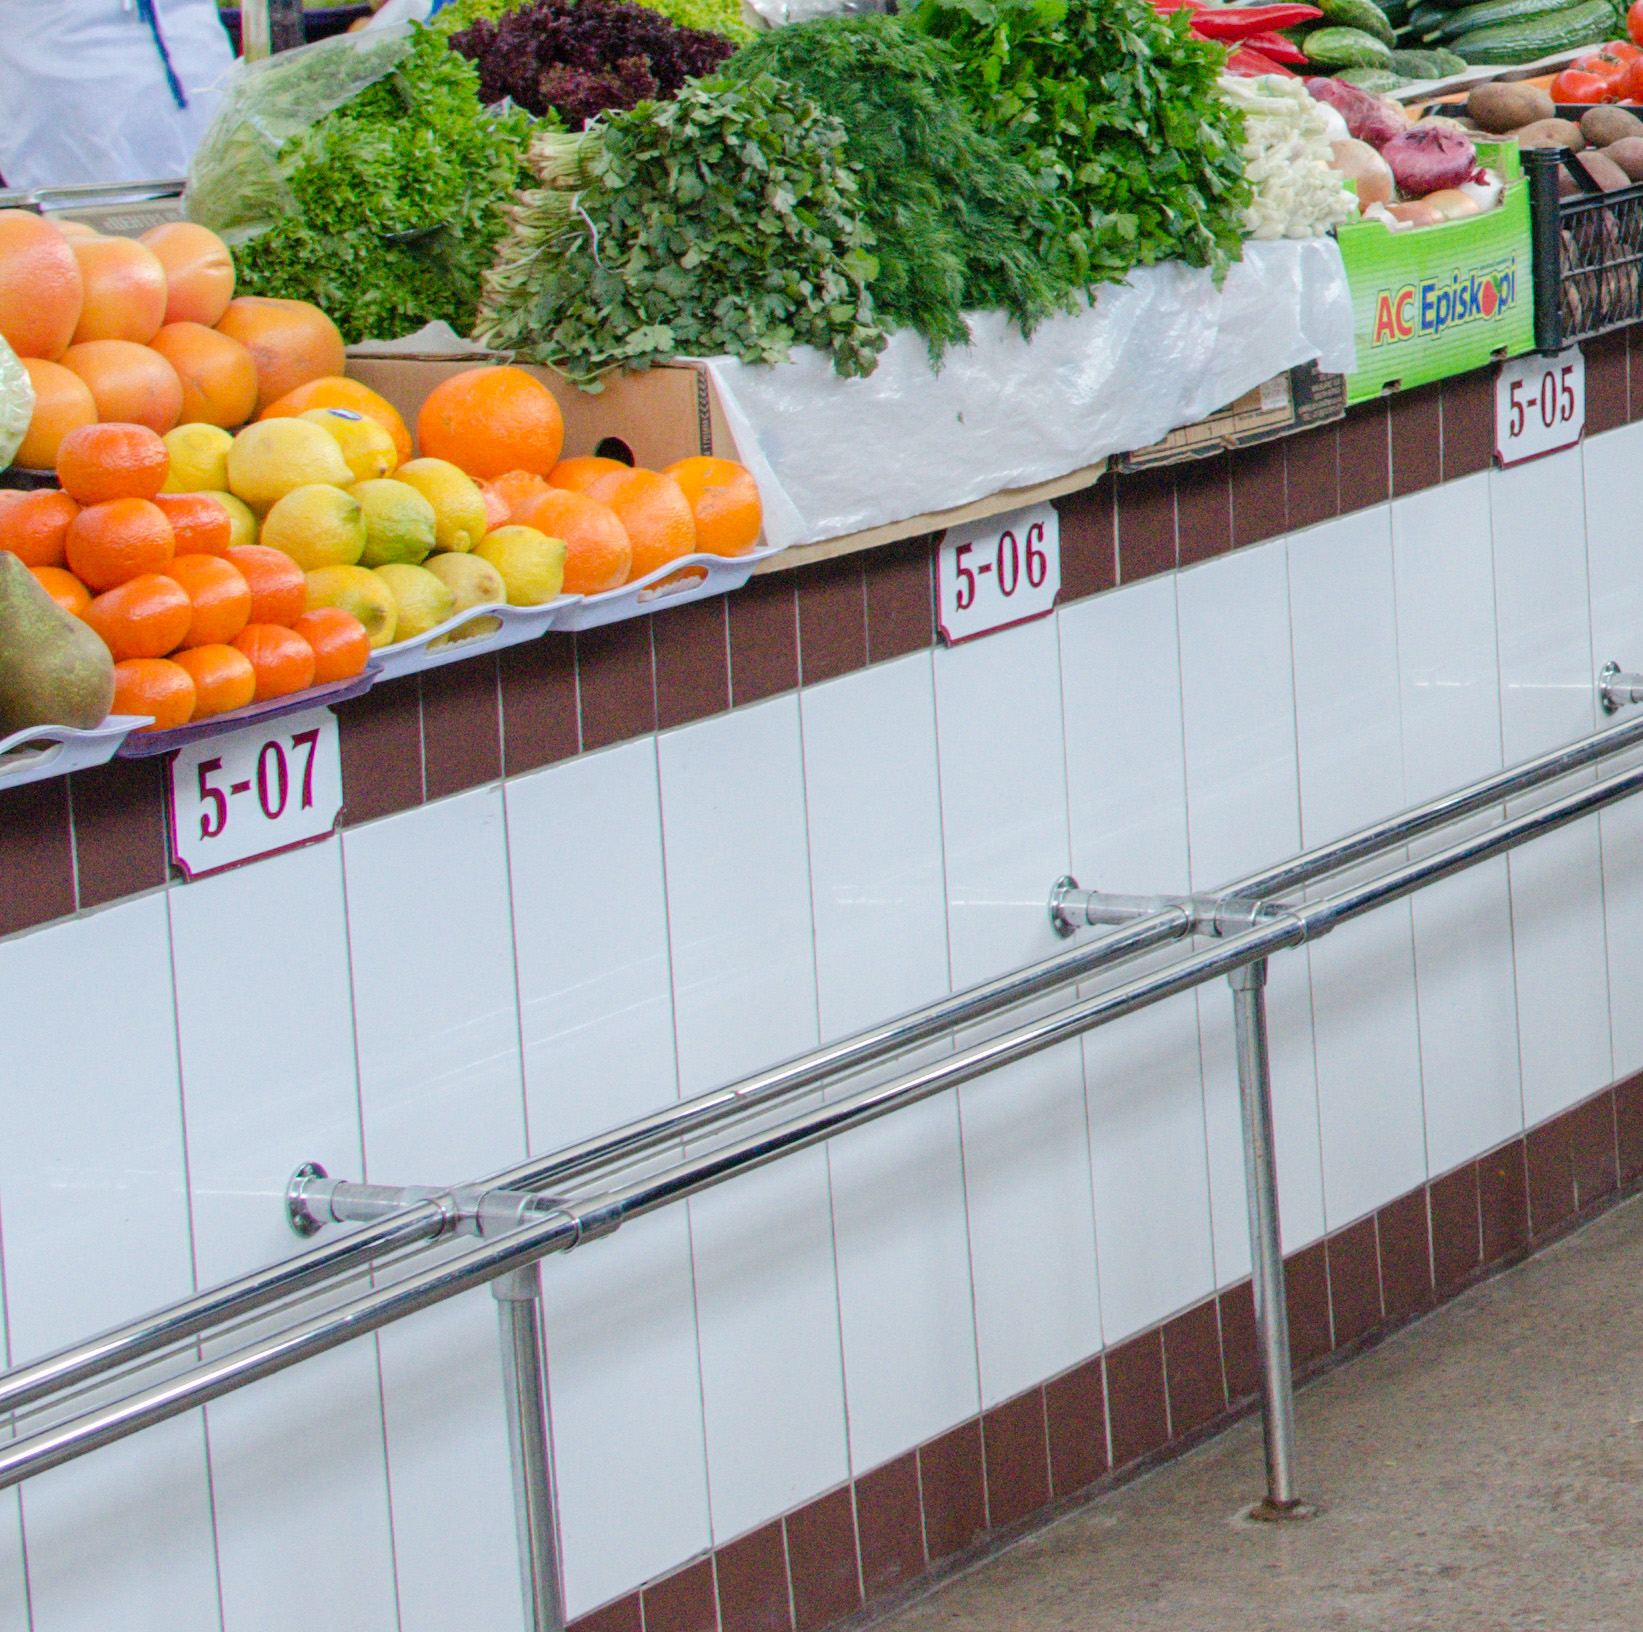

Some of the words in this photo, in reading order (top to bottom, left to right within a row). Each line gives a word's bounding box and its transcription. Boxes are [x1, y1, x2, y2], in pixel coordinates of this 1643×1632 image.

[1372, 282, 1417, 348] AC
[1509, 364, 1574, 439] 5-05
[956, 521, 1047, 613] 5-06
[198, 728, 320, 841] 5-07
